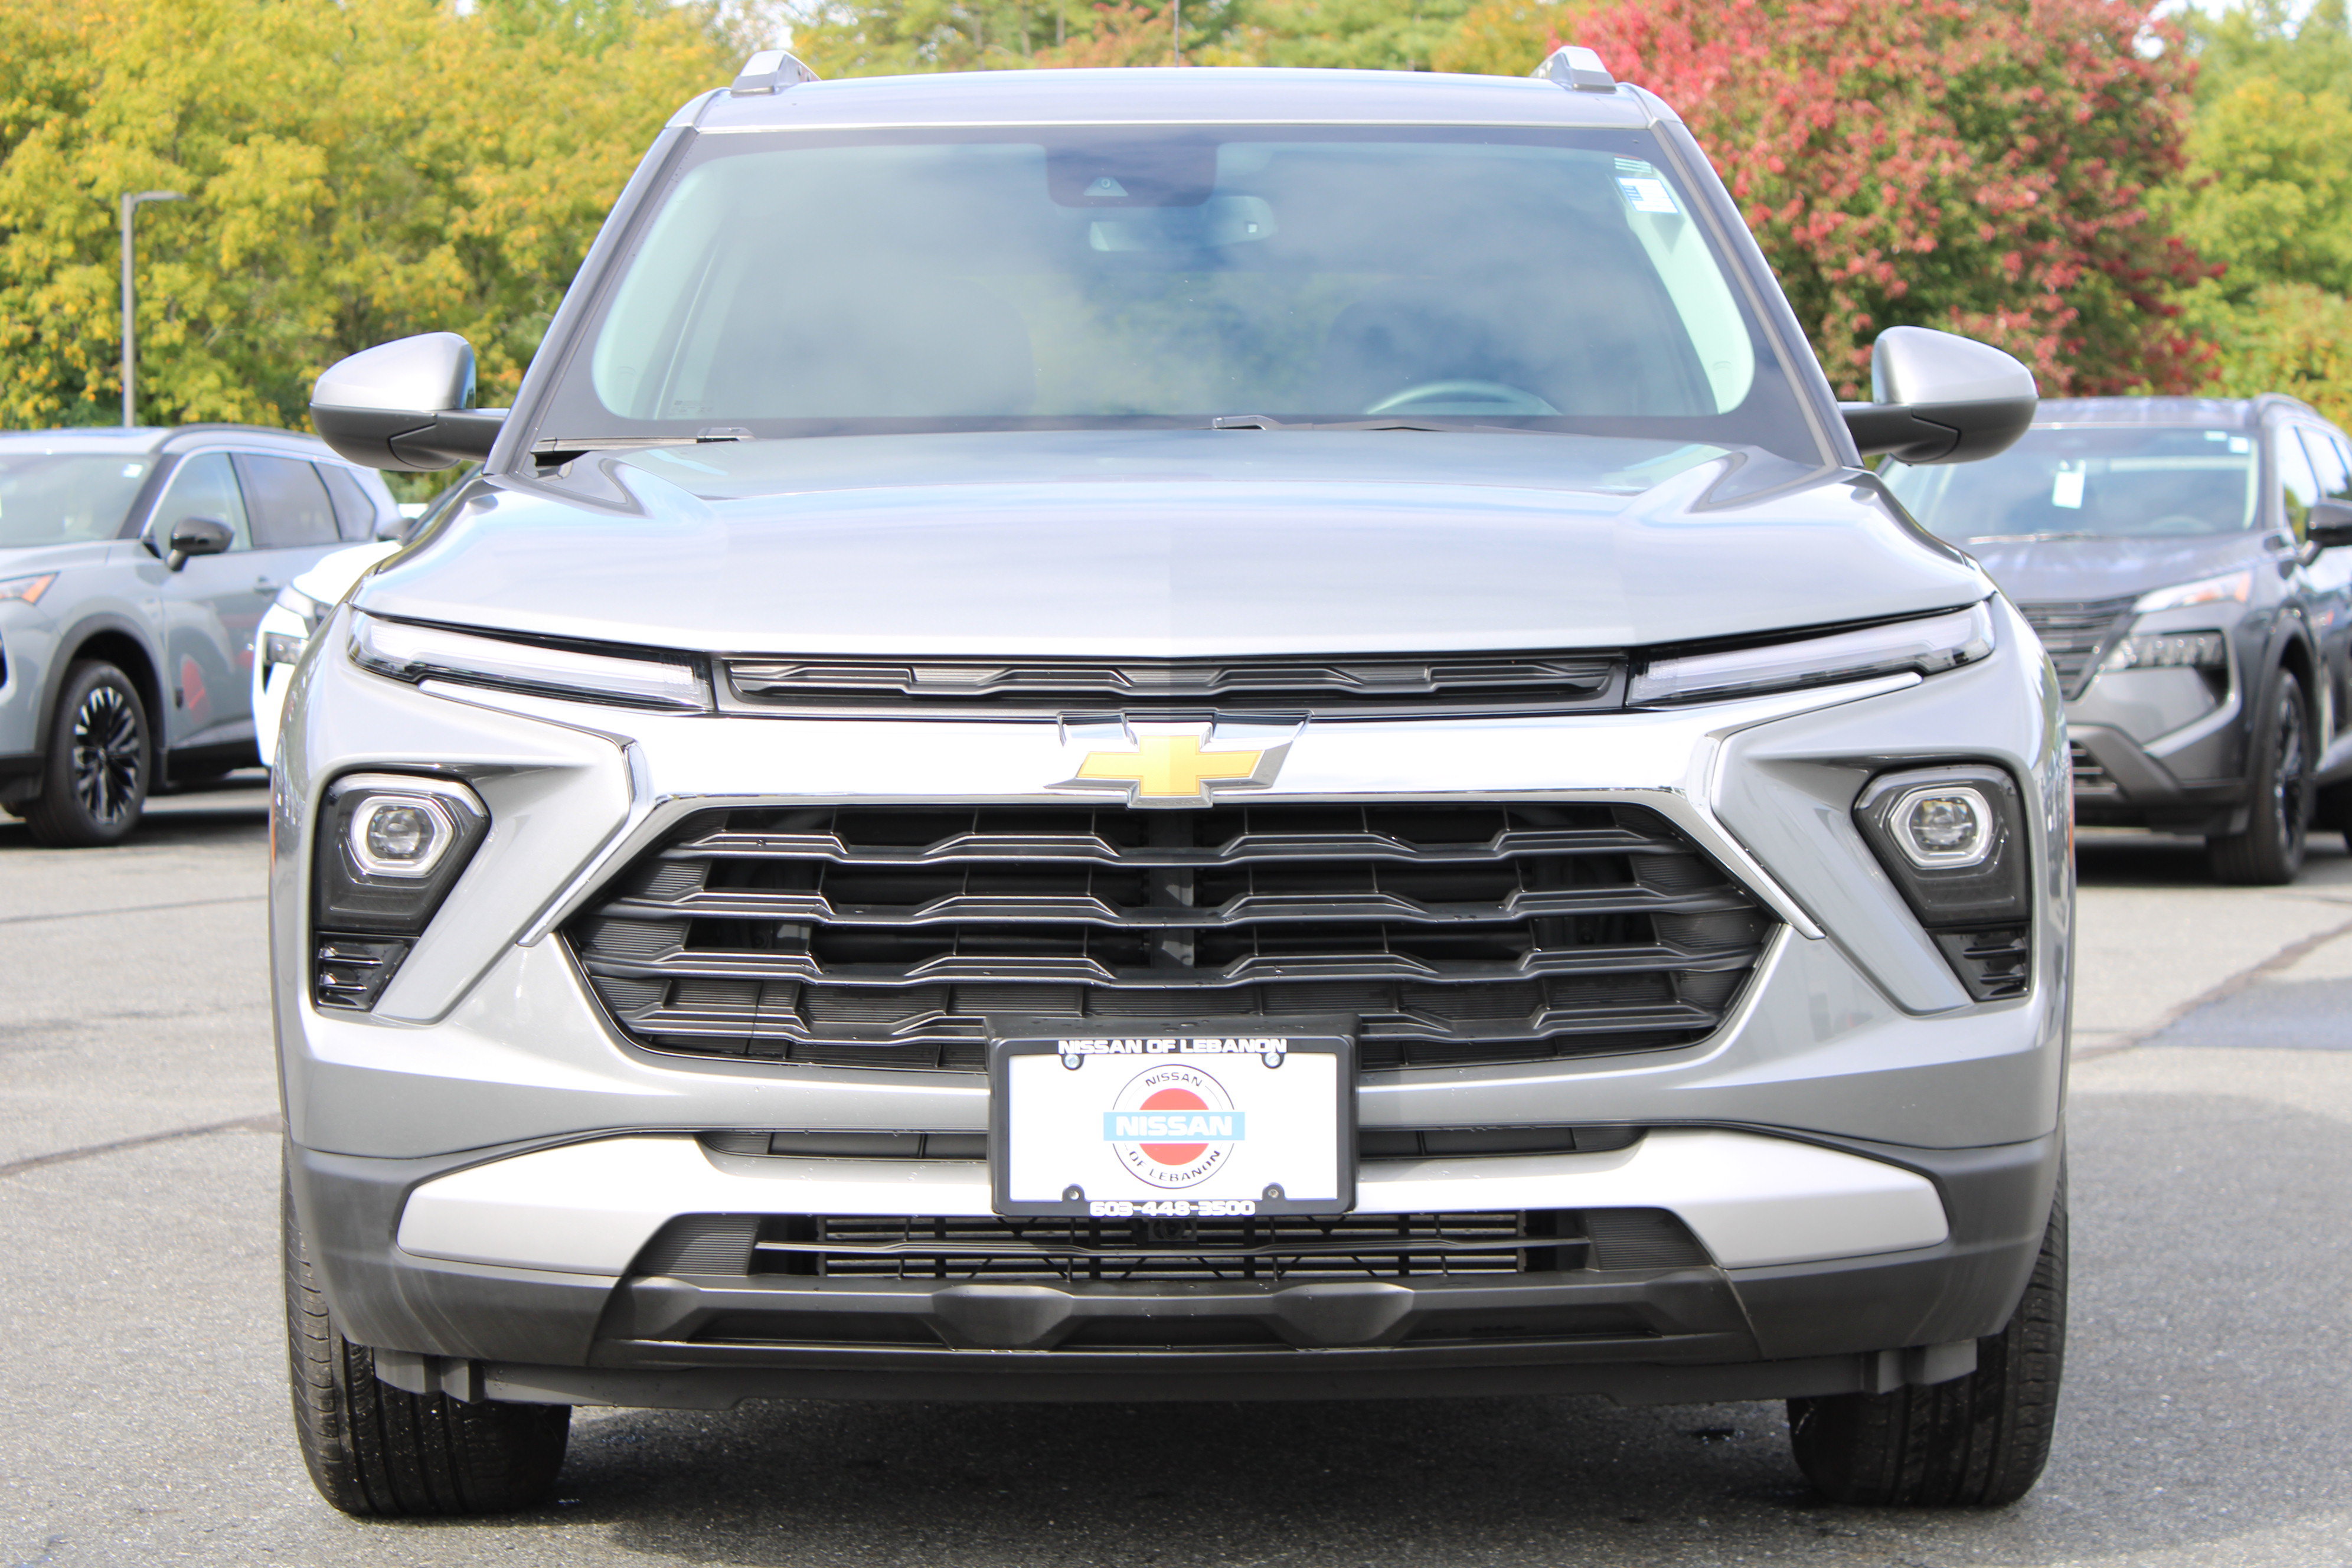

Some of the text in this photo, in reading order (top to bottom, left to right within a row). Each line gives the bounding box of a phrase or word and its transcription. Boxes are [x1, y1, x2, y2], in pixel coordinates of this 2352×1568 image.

[1058, 1038, 1288, 1054] NISSAN OF LEBANON
[1145, 1072, 1203, 1087] NISSAN
[1116, 1116, 1232, 1136] NISSAN
[1129, 1151, 1220, 1182] OF LEBANON
[1090, 1200, 1256, 1217] 603-448-3500
